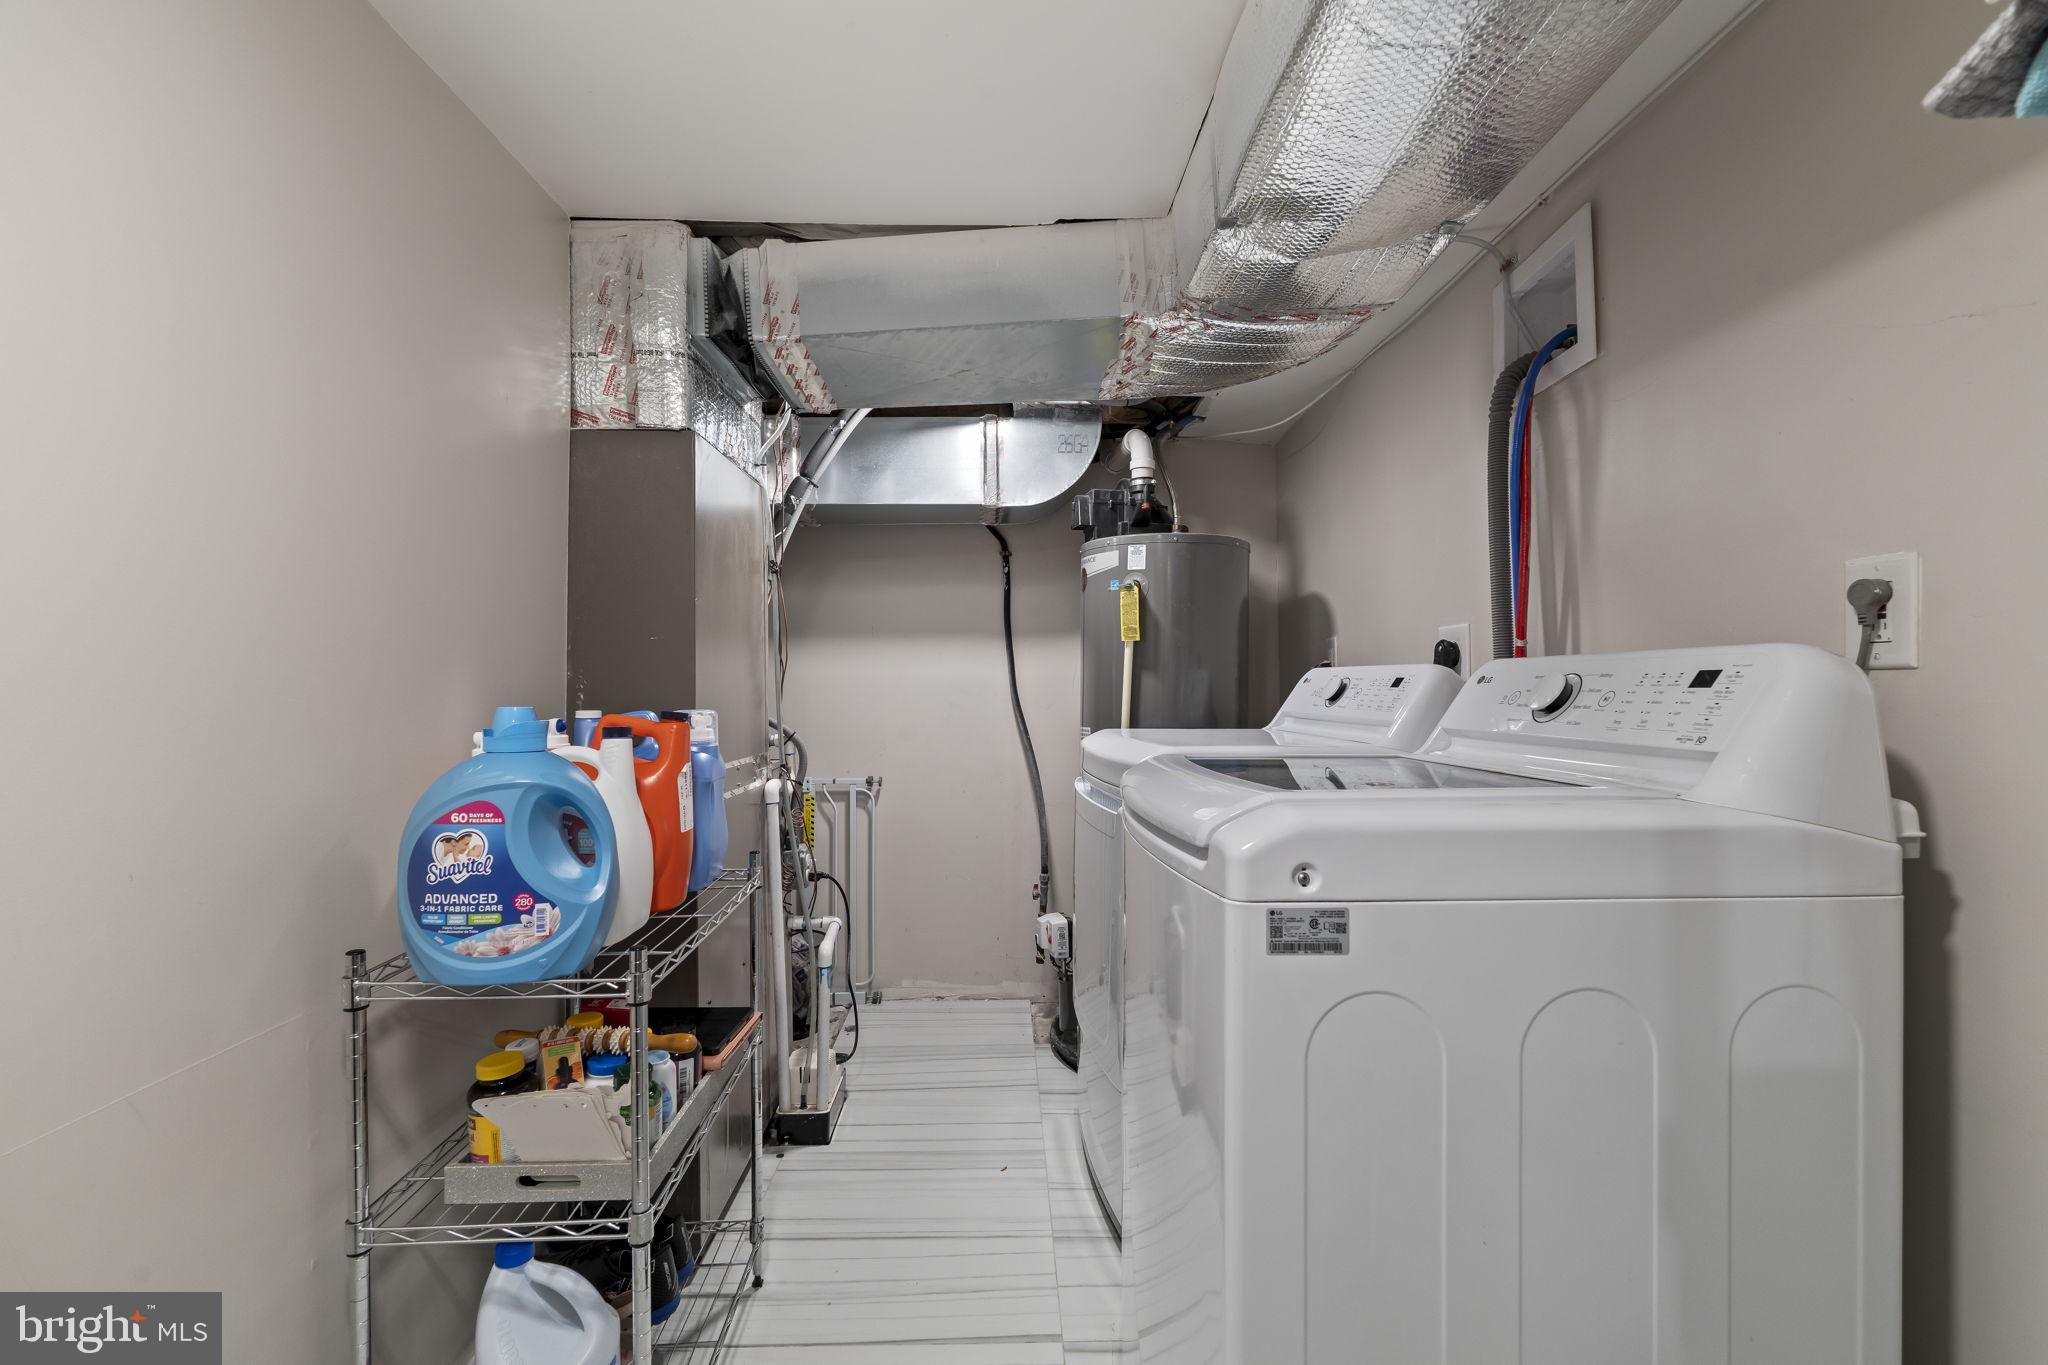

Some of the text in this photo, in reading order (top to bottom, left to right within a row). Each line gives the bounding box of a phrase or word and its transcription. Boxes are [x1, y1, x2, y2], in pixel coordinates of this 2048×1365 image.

[450, 812, 468, 823] 60
[427, 855, 493, 884] Suavitel
[424, 893, 498, 905] ADVANCED
[514, 897, 533, 907] 280
[478, 904, 503, 912] CARE
